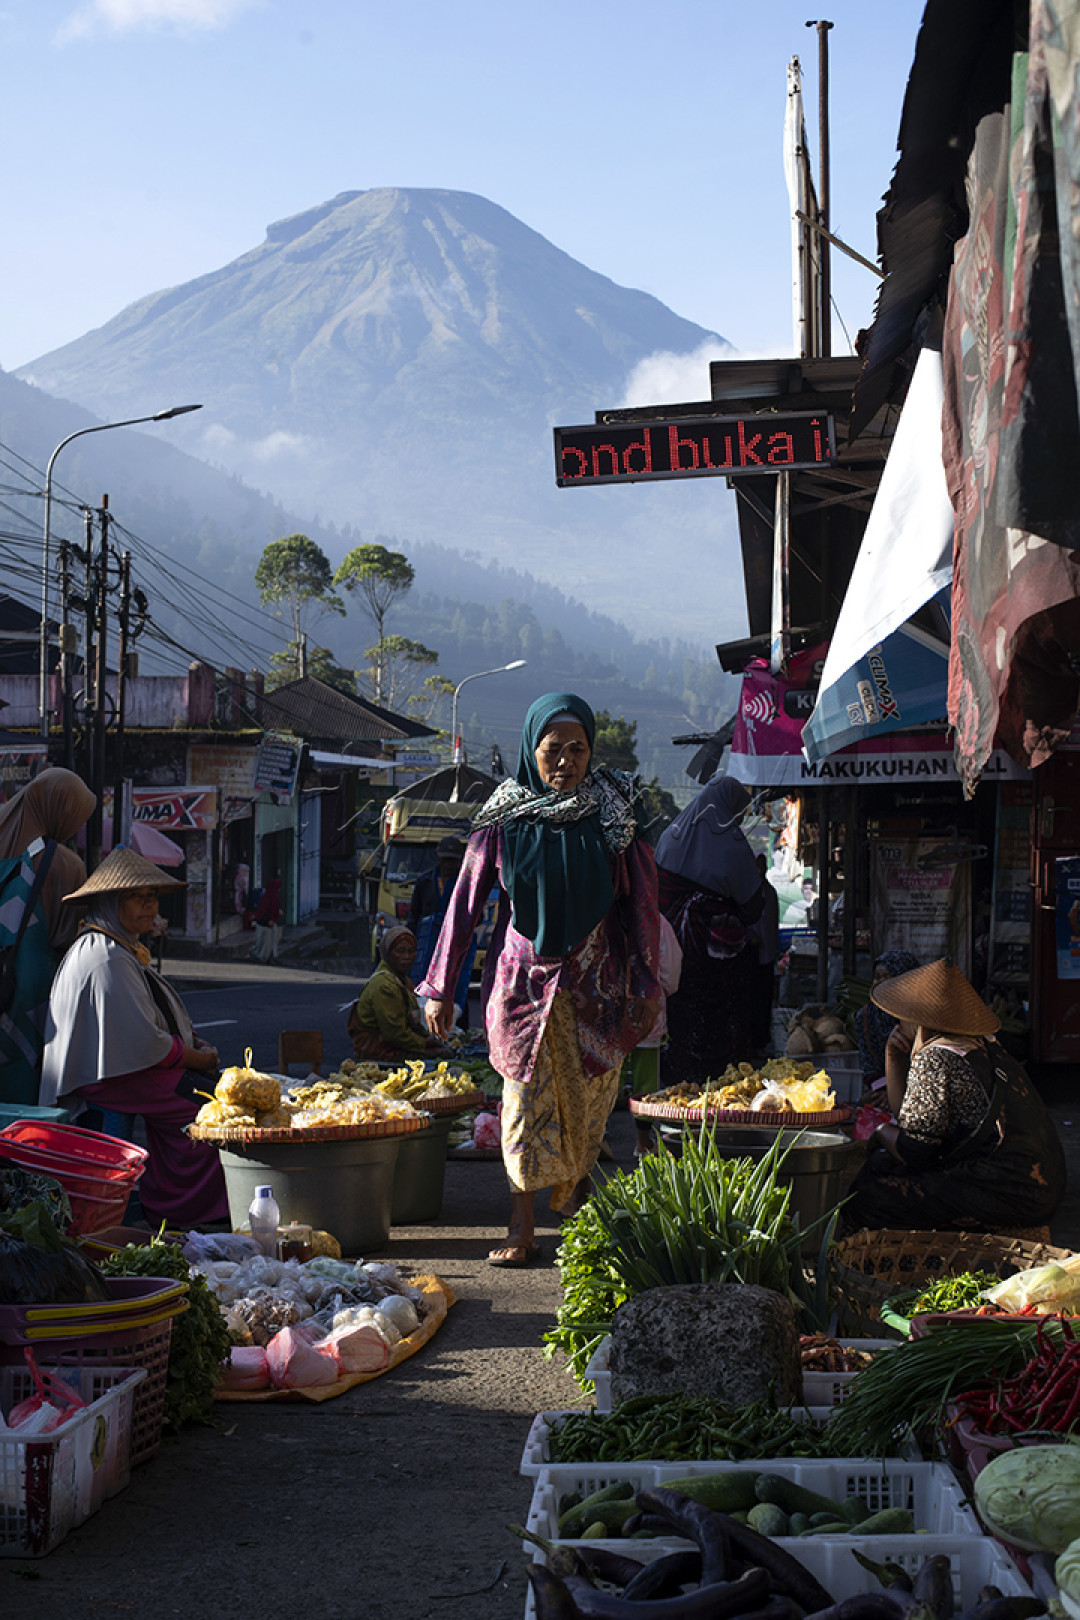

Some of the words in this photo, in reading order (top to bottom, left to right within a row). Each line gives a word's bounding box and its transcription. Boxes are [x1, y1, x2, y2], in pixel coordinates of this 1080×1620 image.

[668, 420, 794, 471] buka
[869, 655, 900, 721] CLIMAX
[800, 758, 948, 778] MAKUKUHAN
[132, 794, 205, 828] LIMAX
